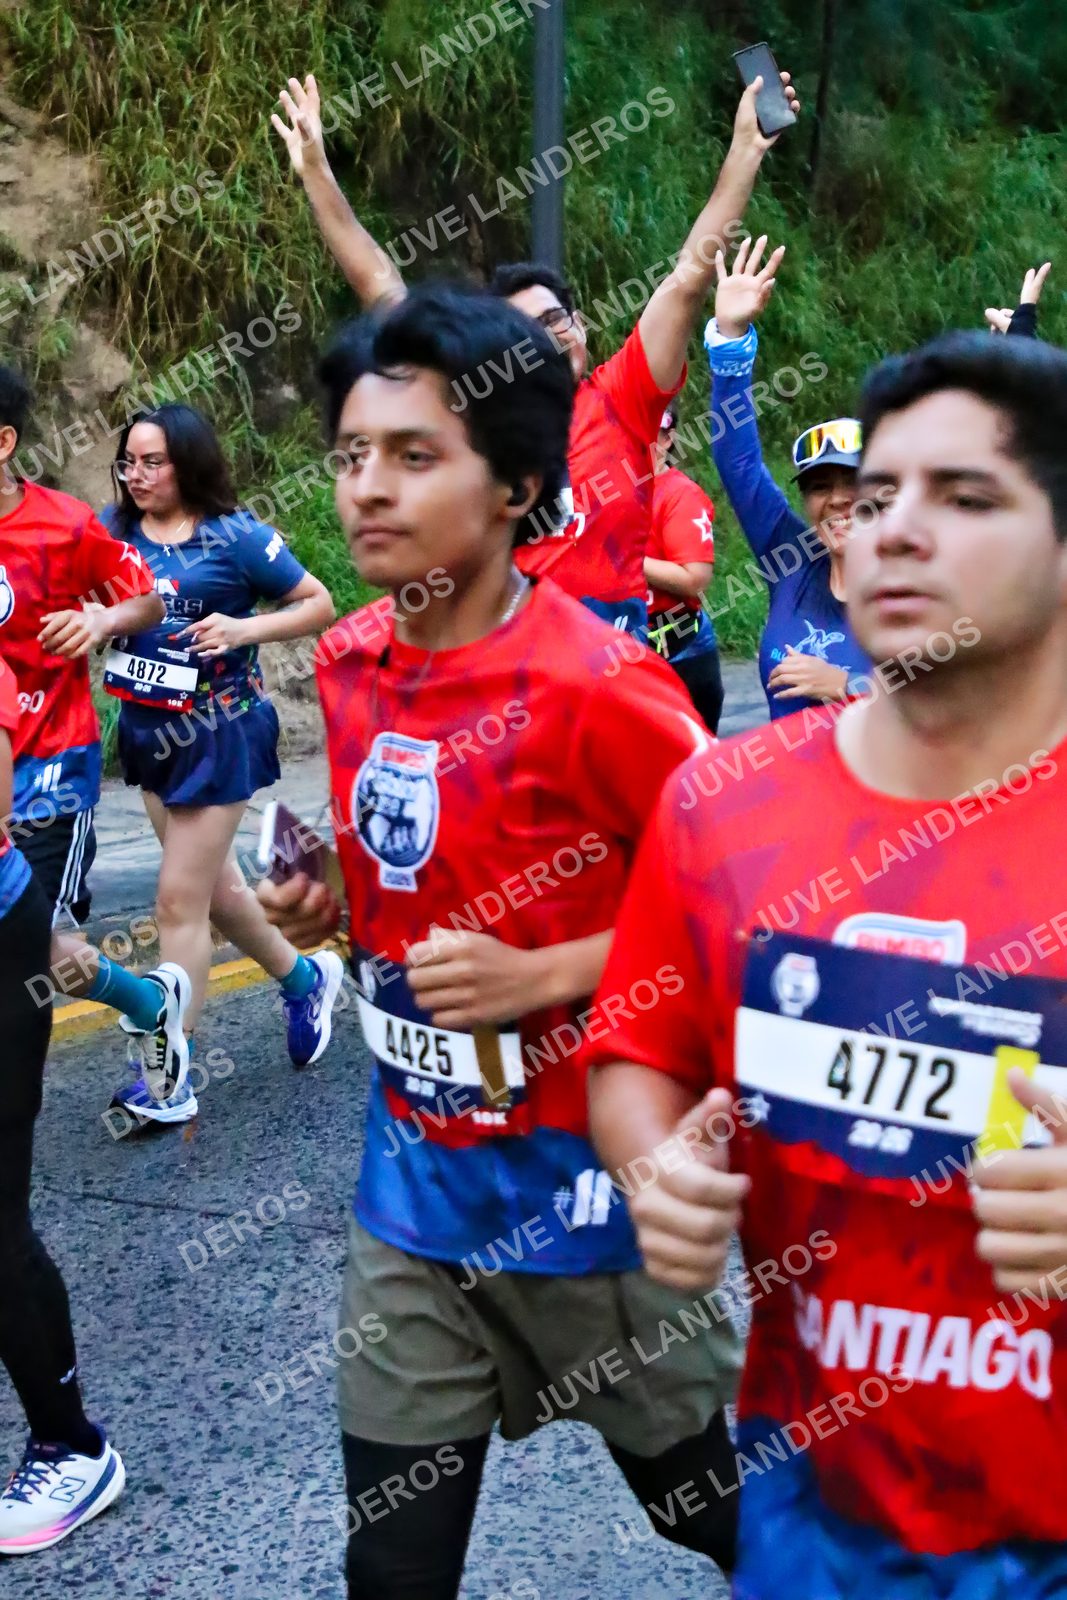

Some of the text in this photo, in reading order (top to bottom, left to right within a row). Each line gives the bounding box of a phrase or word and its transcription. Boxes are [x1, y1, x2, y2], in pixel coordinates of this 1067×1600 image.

[127, 658, 167, 684] 4872
[386, 1018, 453, 1077] 4425
[827, 1039, 957, 1120] 4772
